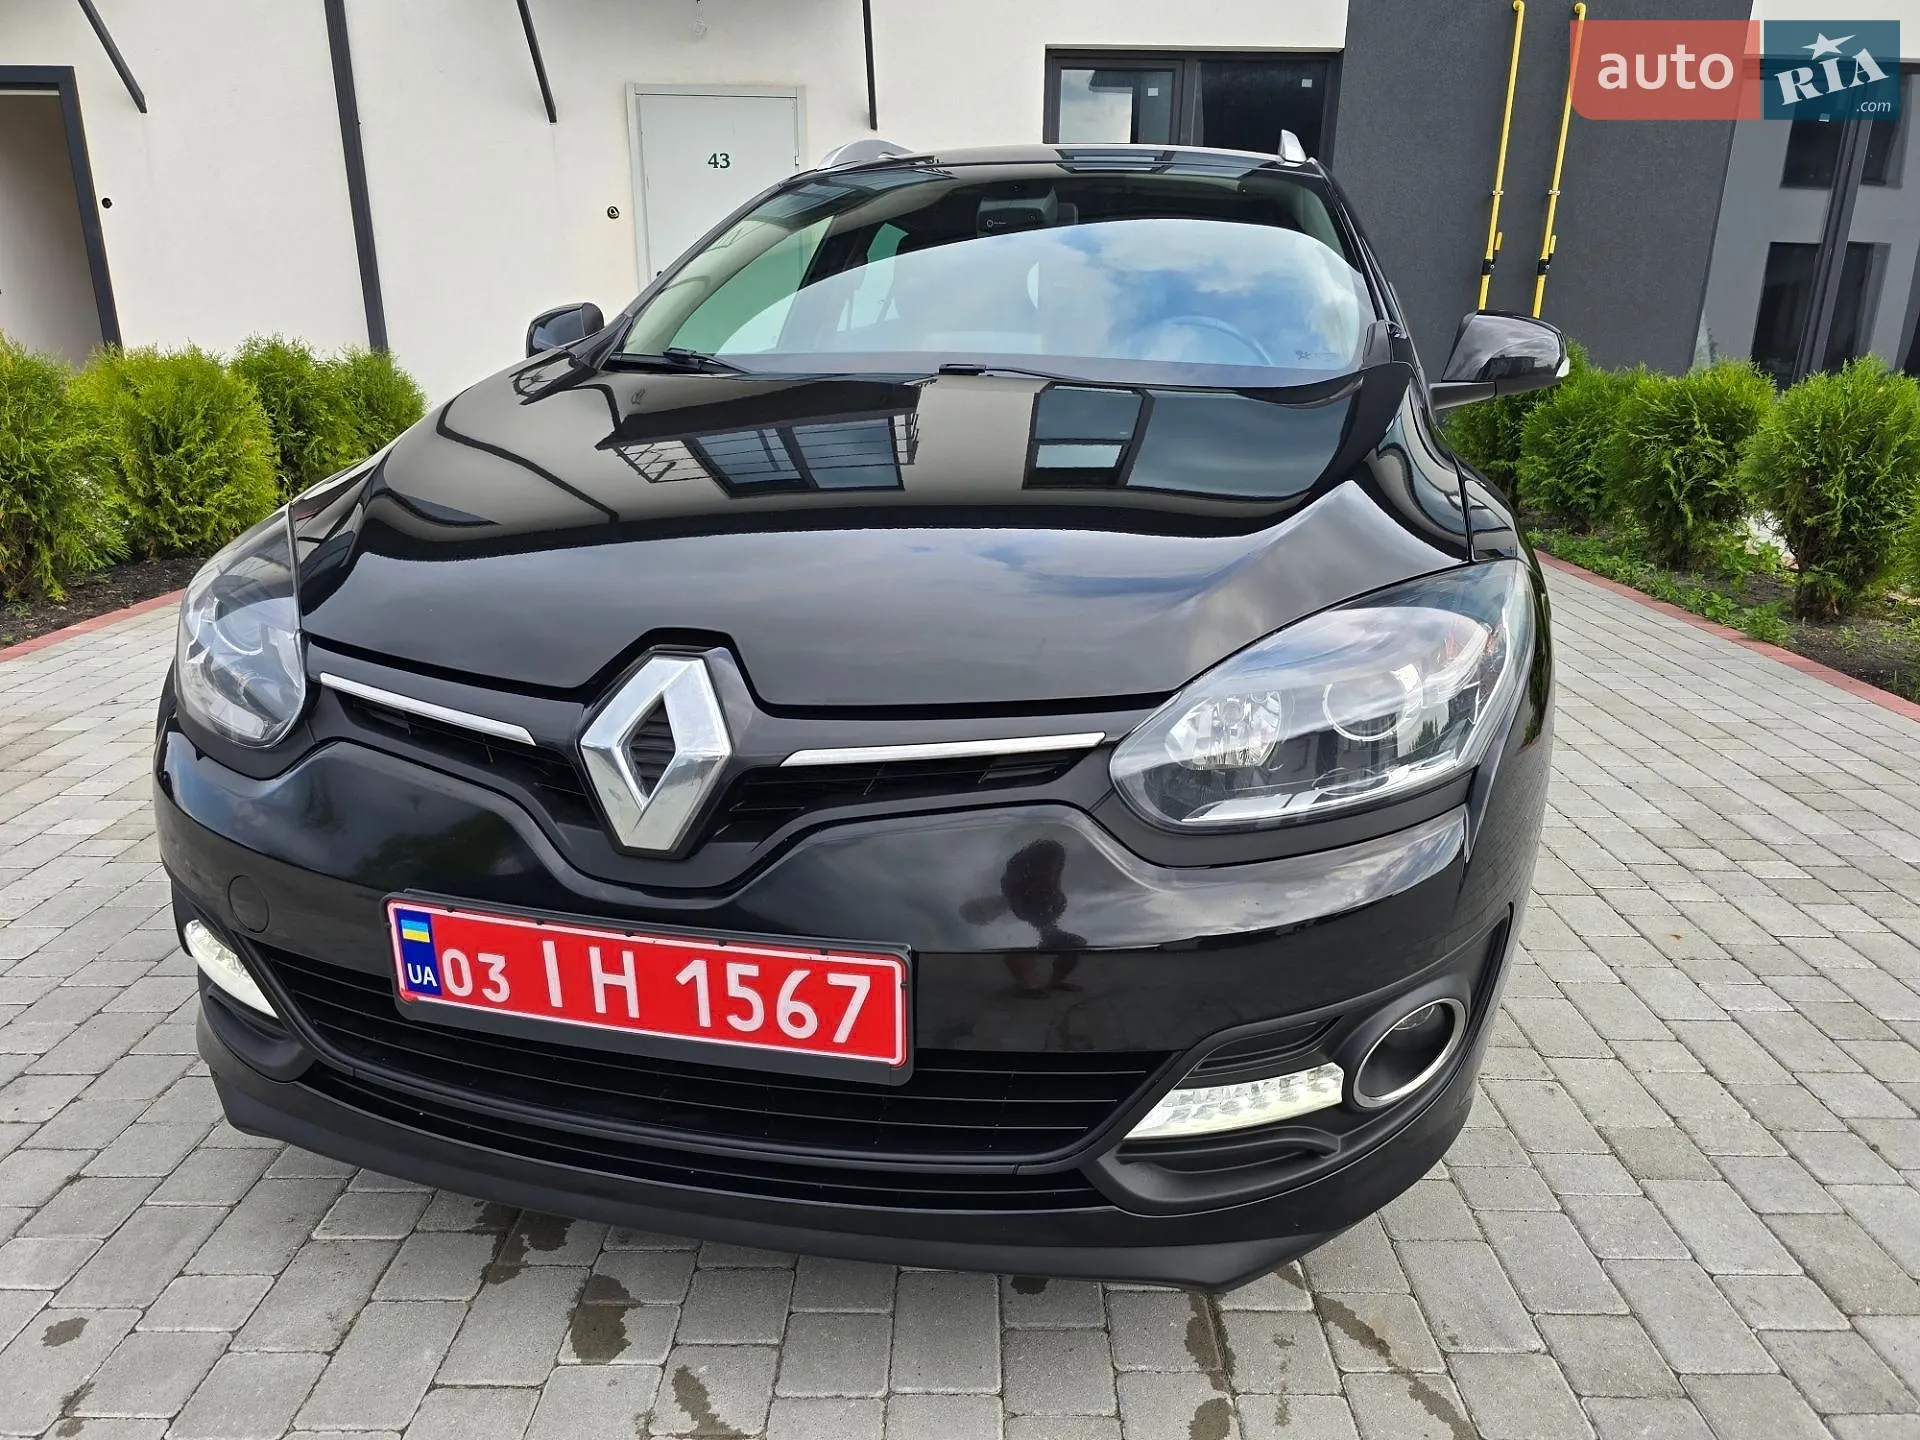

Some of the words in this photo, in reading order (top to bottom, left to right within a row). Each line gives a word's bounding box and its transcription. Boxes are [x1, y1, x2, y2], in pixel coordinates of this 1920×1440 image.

[707, 152, 731, 169] 43
[407, 962, 437, 987] UA
[441, 948, 511, 1003] 03
[675, 959, 871, 1044] 1567
